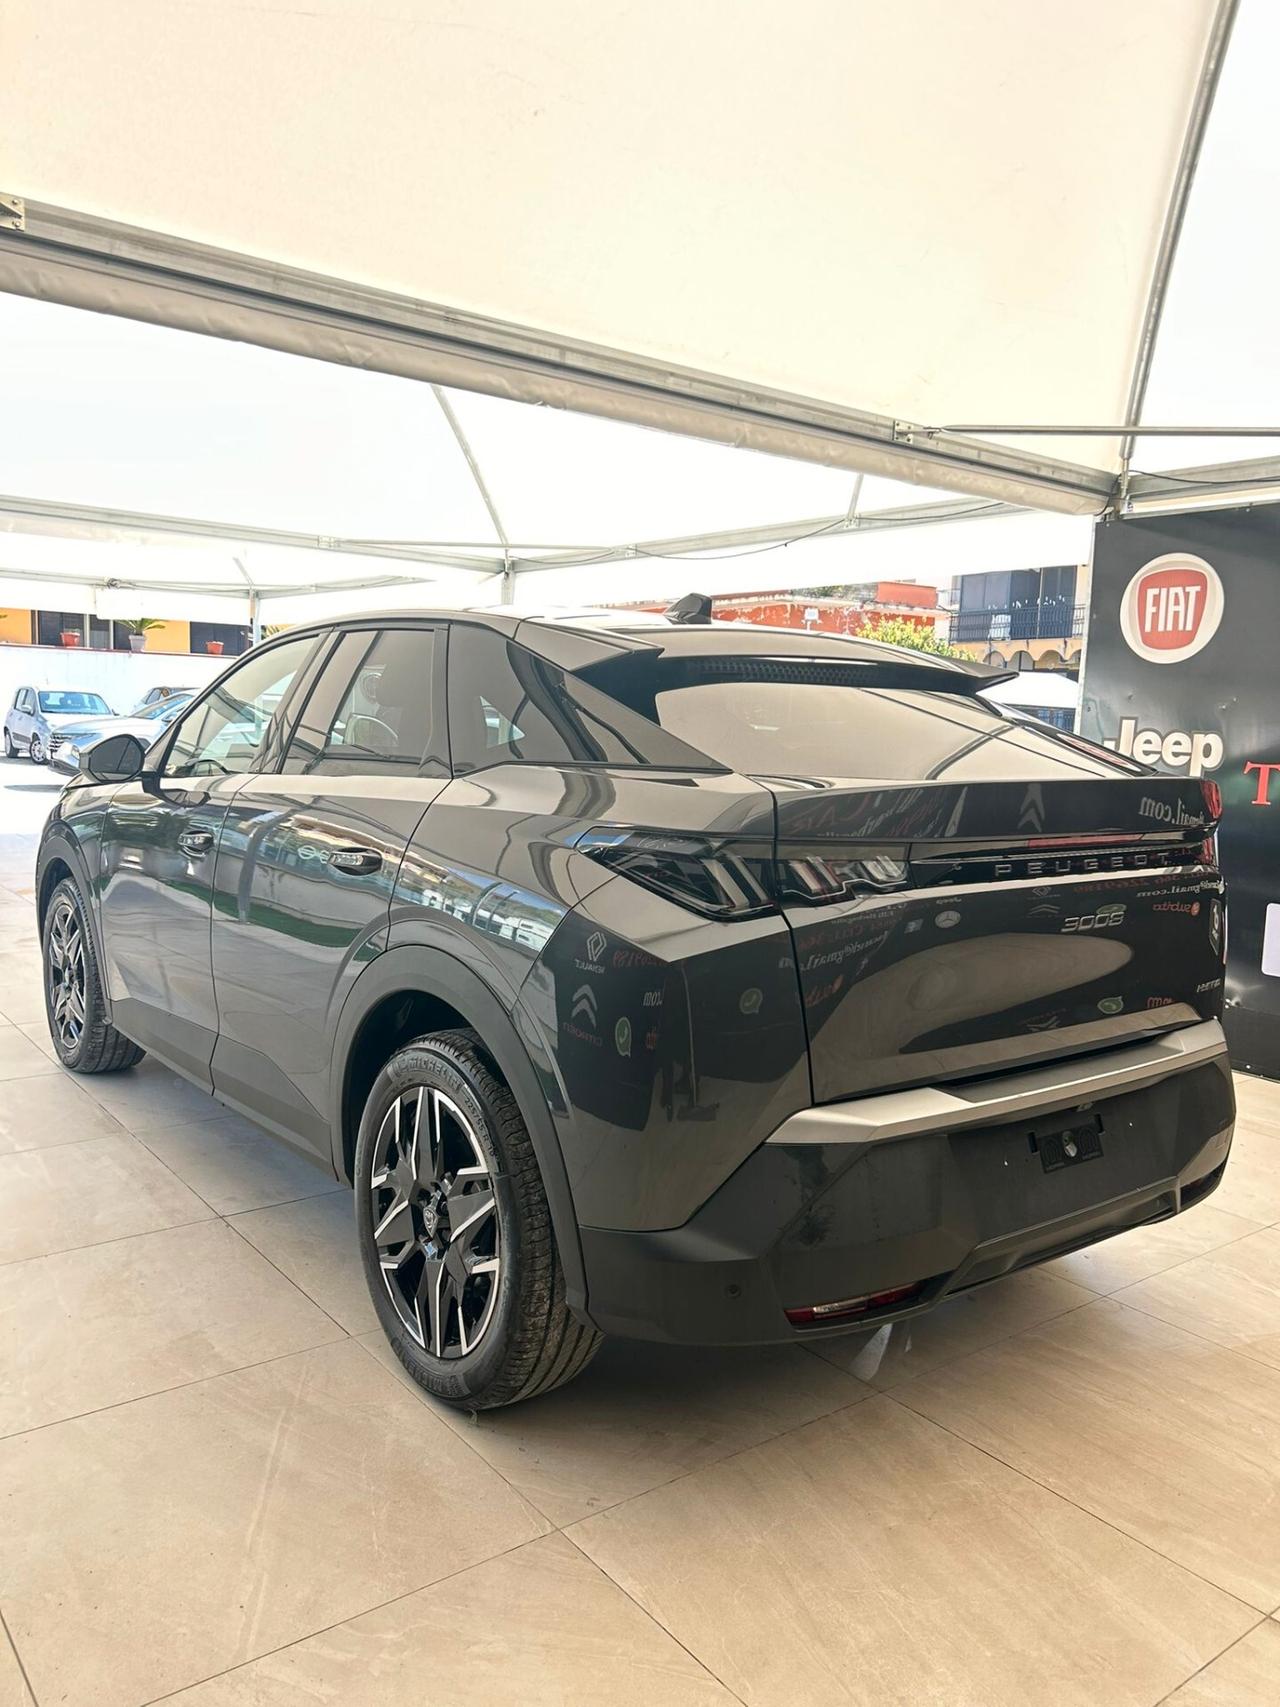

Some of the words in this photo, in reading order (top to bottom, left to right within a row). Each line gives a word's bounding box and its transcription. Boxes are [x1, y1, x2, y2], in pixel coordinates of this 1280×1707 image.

[1145, 585, 1201, 633] FIAT
[1105, 718, 1223, 776] Jeep
[994, 852, 1170, 876] PEUGEOT
[1061, 911, 1125, 933] 3008
